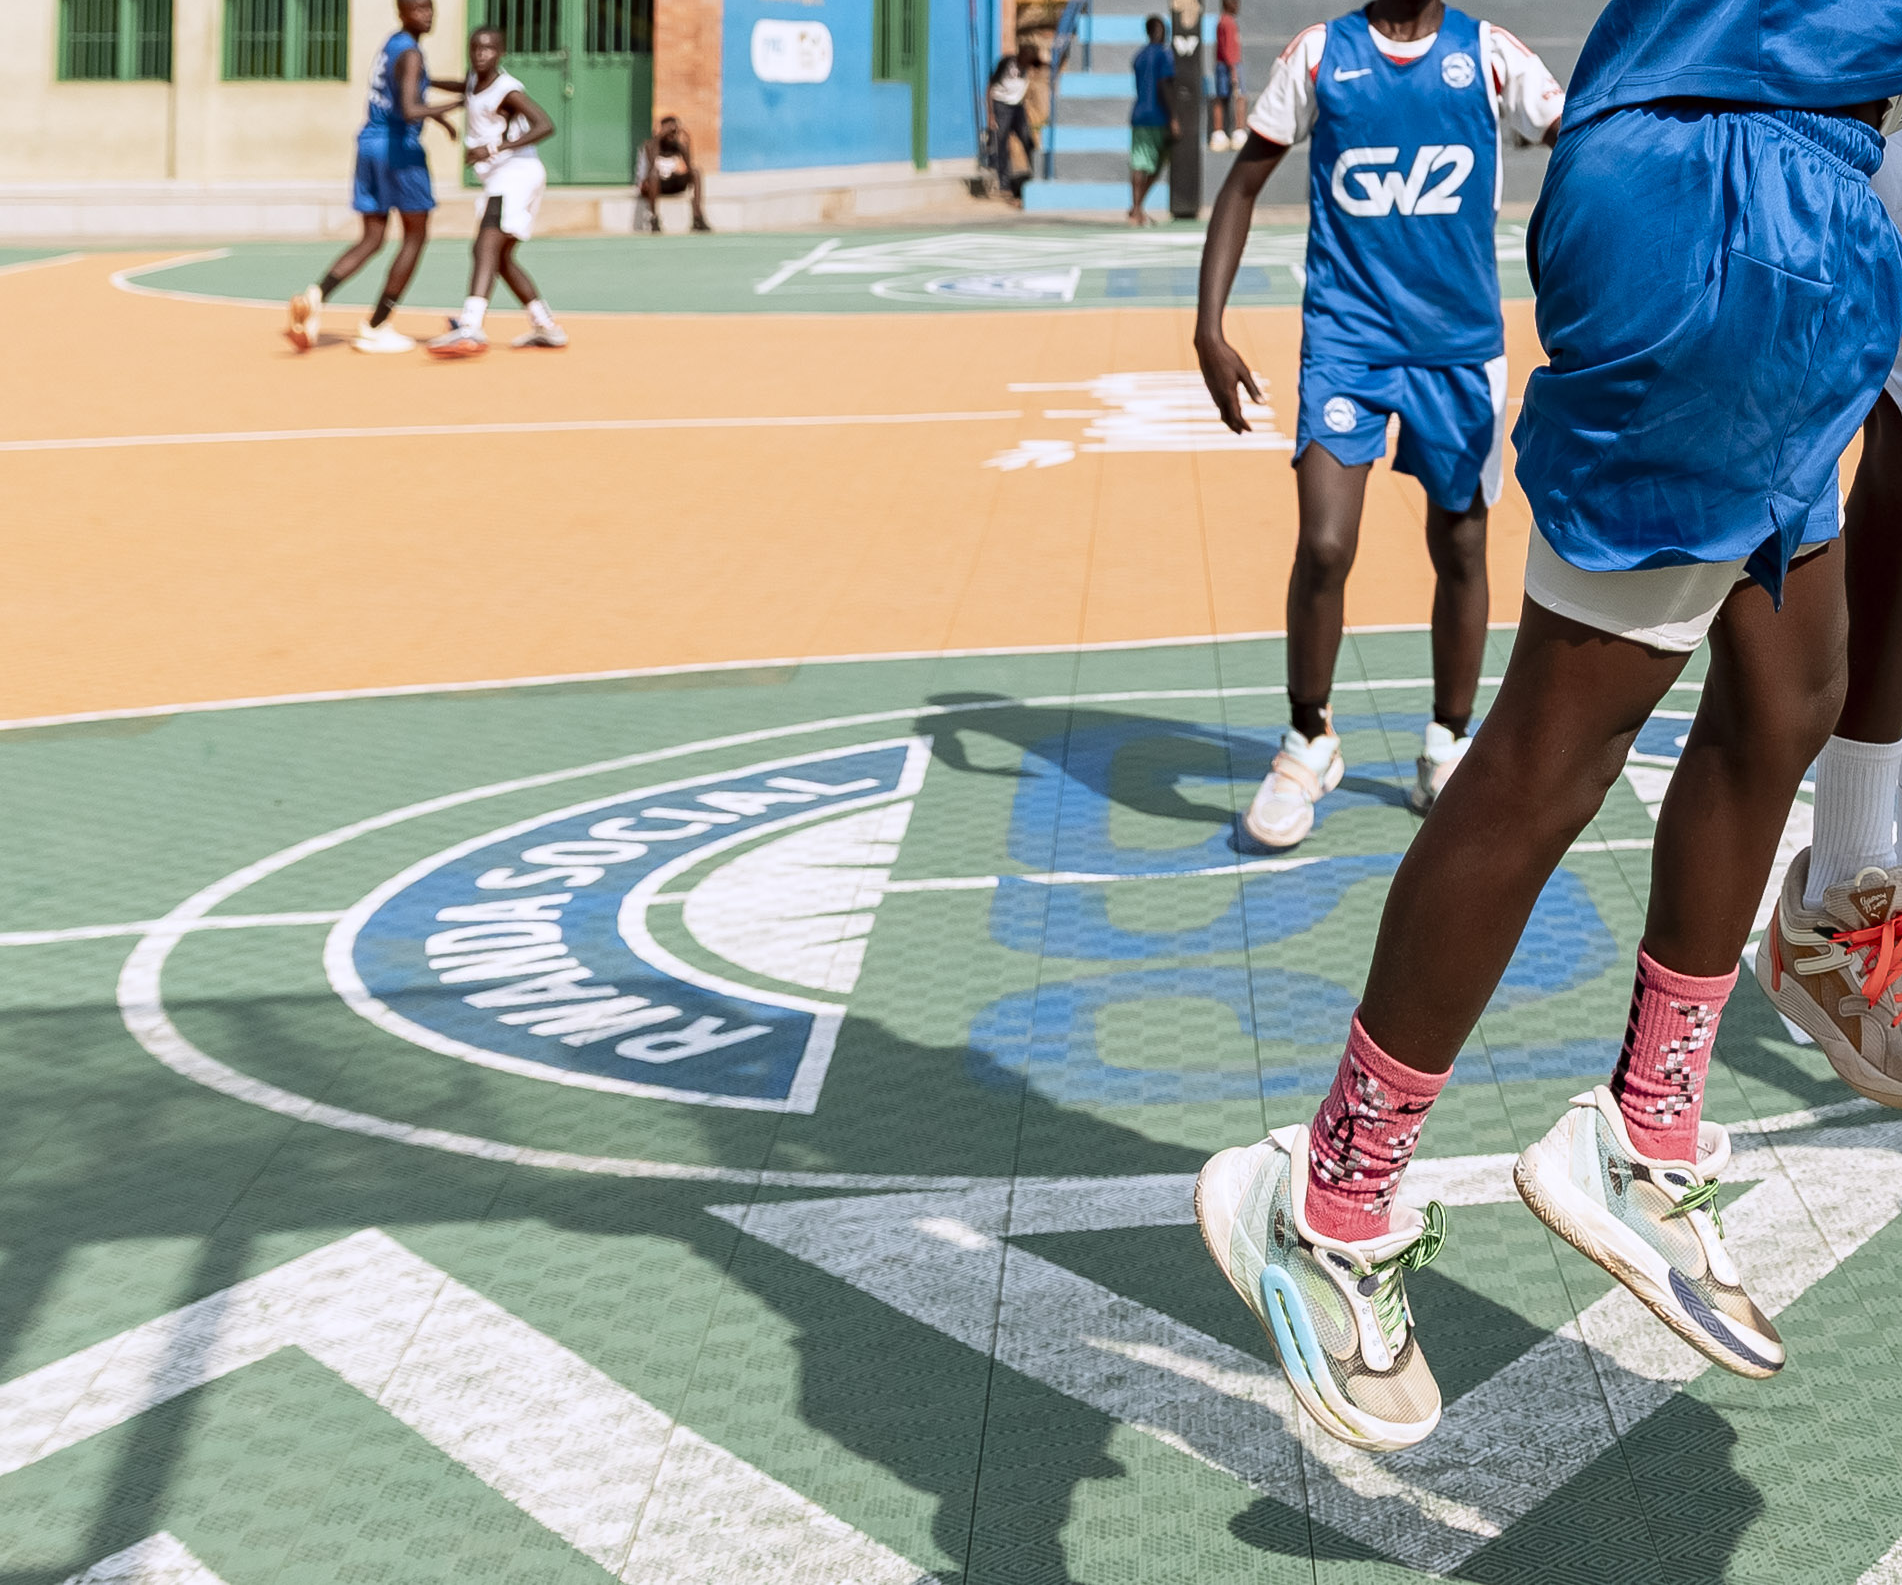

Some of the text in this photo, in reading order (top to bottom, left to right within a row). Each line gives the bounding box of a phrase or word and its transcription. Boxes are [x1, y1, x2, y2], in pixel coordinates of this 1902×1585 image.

[1331, 144, 1475, 217] GW2
[475, 777, 881, 890] SOCIAL
[424, 892, 774, 1064] RWANDA
